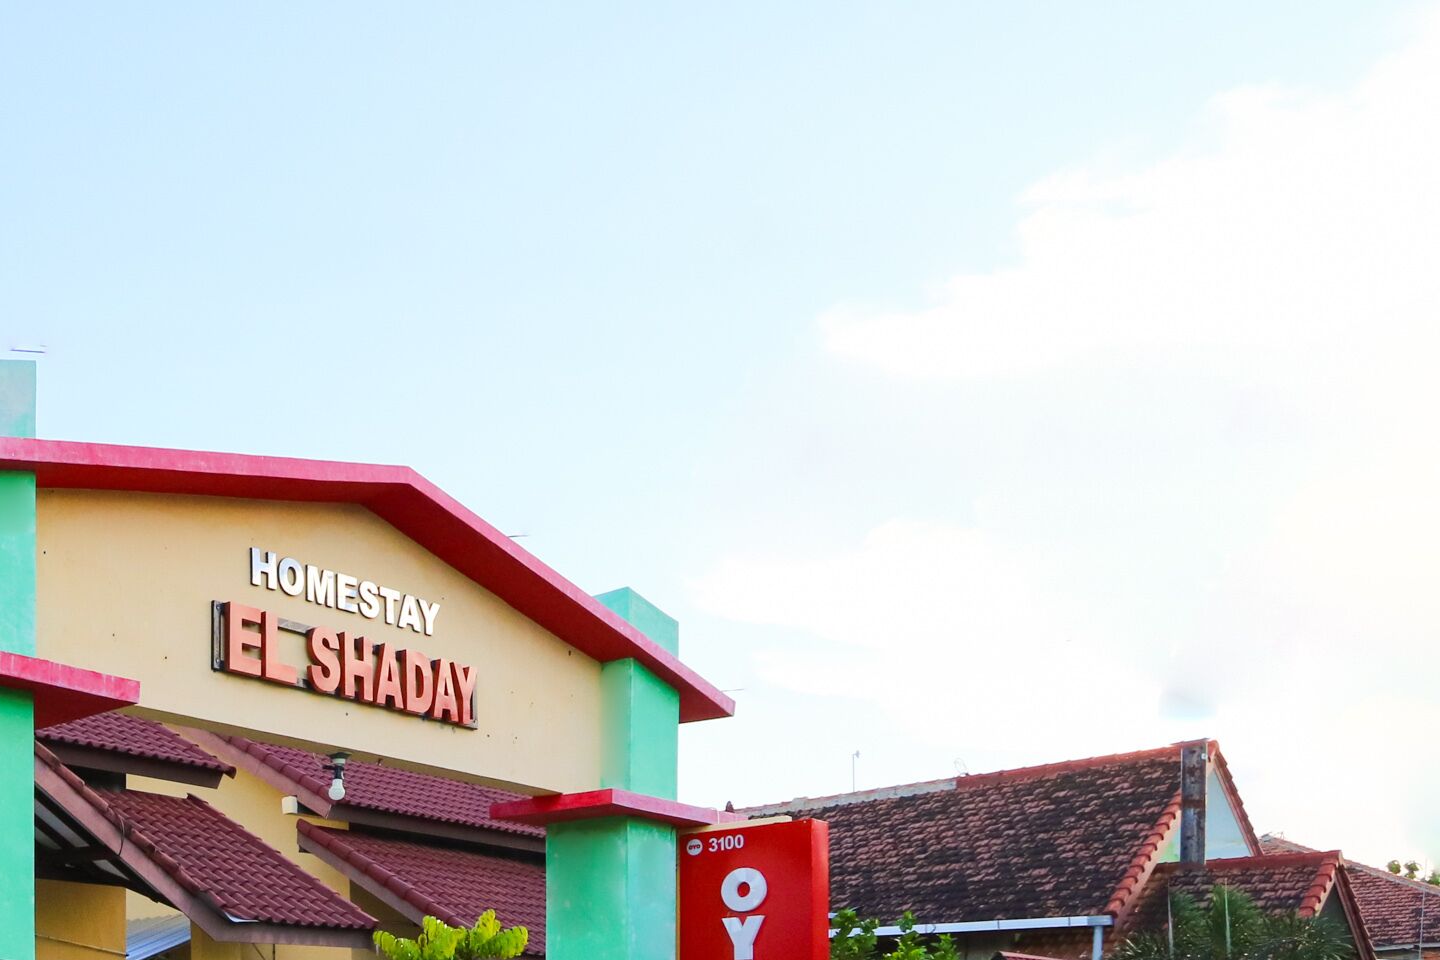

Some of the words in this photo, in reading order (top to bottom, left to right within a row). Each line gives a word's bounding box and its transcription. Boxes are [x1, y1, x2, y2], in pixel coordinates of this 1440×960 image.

[249, 547, 440, 636] HOMESTAY
[224, 601, 297, 684] EL
[307, 626, 477, 725] SHADAY
[708, 834, 744, 852] 3100
